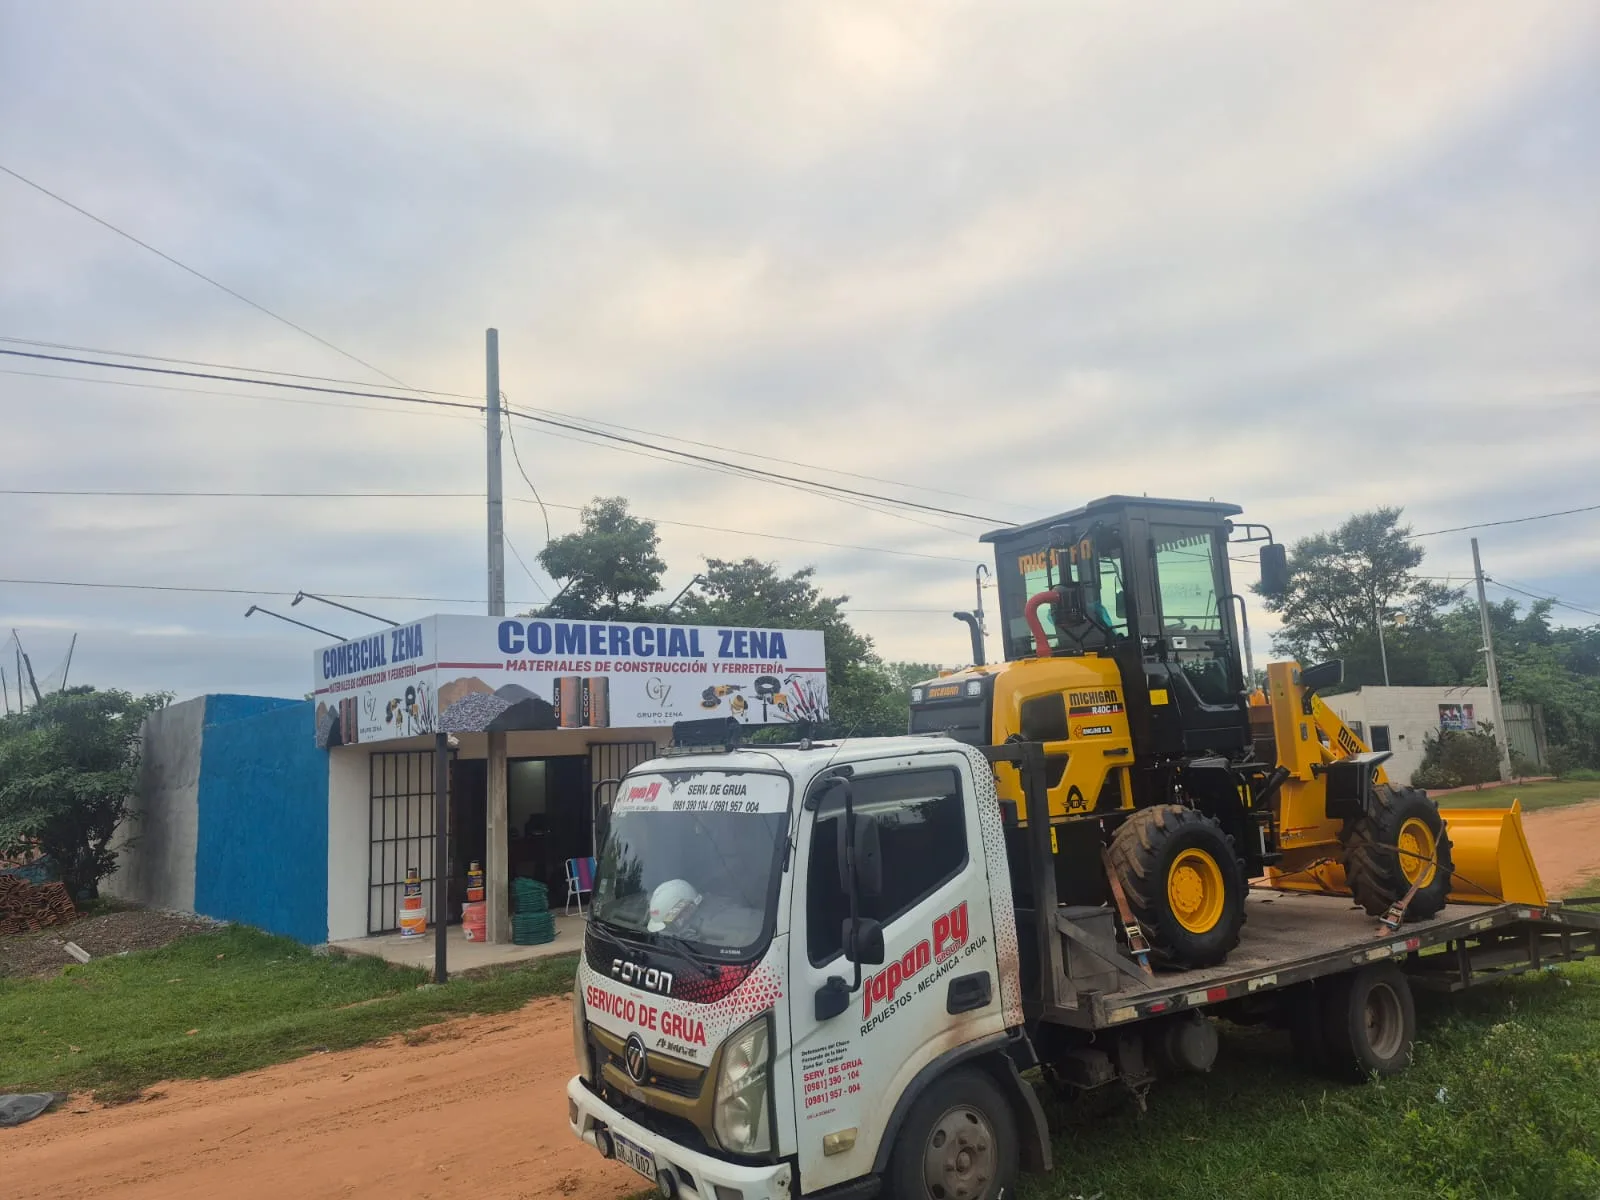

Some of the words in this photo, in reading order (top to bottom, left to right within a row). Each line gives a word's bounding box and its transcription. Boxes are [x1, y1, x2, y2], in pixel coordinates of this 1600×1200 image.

[497, 620, 705, 658] COMERCIAL
[718, 629, 787, 659] ZENA
[323, 633, 387, 680] COMERCIAL
[391, 623, 424, 663] ZENA
[505, 659, 592, 672] MATERIALES
[594, 660, 611, 672] DE
[614, 659, 707, 673] CONSTRUCCIÓN
[712, 662, 720, 673] Y
[721, 661, 784, 674] FERRETERÍA
[1069, 689, 1118, 706] MICHIGAN
[687, 784, 708, 796] SERV.
[709, 784, 721, 795] DE
[722, 784, 747, 796] GRUA
[713, 800, 729, 813] 0981
[729, 800, 743, 812] 957
[745, 802, 760, 812] 004
[611, 958, 673, 994] FOTON
[860, 991, 913, 1037] REPUESTOS
[917, 956, 960, 993] MECÁNICA
[964, 934, 988, 957] GRÚA
[586, 984, 636, 1024] SERVICIO
[638, 1004, 658, 1031] DE
[660, 1011, 707, 1047] GRUA
[803, 1067, 827, 1082] SERV.
[828, 1064, 840, 1075] DE
[840, 1057, 863, 1072] GRUA
[828, 1075, 842, 1087] 390
[847, 1069, 860, 1081] 104
[829, 1088, 843, 1100] 957
[848, 1082, 862, 1094] 004
